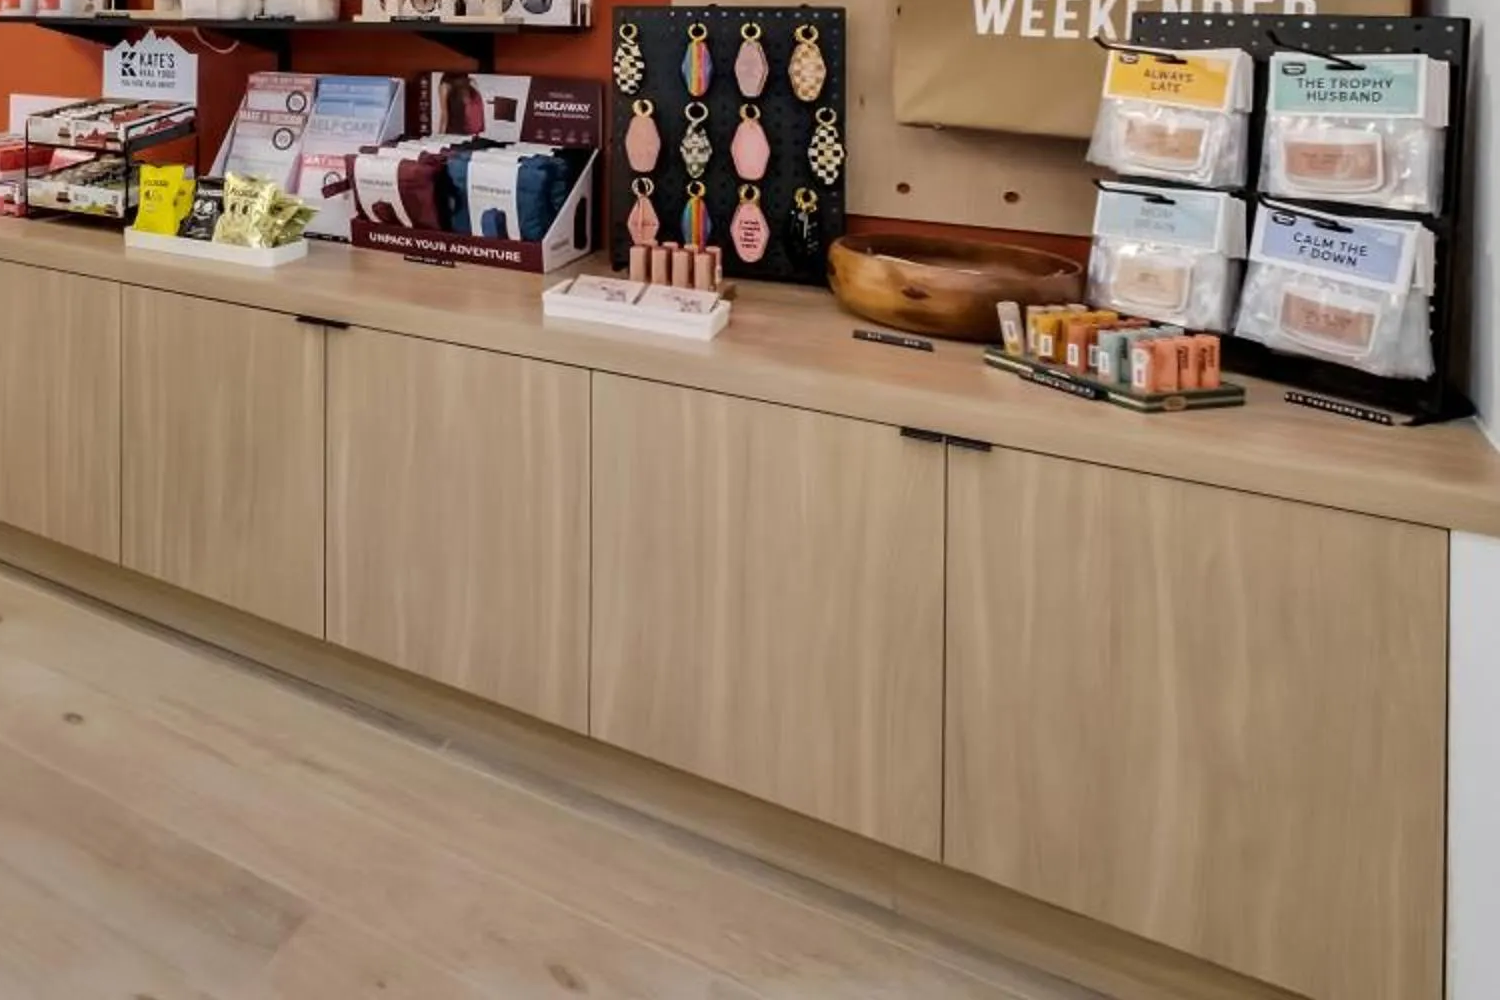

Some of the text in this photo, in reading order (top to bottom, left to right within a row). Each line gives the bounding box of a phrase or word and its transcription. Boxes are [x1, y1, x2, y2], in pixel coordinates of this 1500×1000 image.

[139, 52, 176, 69] KATE'S
[1143, 67, 1195, 83] ALWAYS
[1297, 76, 1394, 89] THE TROPHY
[1151, 81, 1182, 94] LATE
[1306, 90, 1383, 103] HUSBAND
[533, 101, 591, 113] HIDEAWAY
[369, 231, 413, 247] UNPACK
[416, 239, 447, 252] YOUR
[450, 243, 522, 263] ADVENTURE
[1293, 231, 1368, 257] CALM THE
[1310, 246, 1358, 267] DOWN
